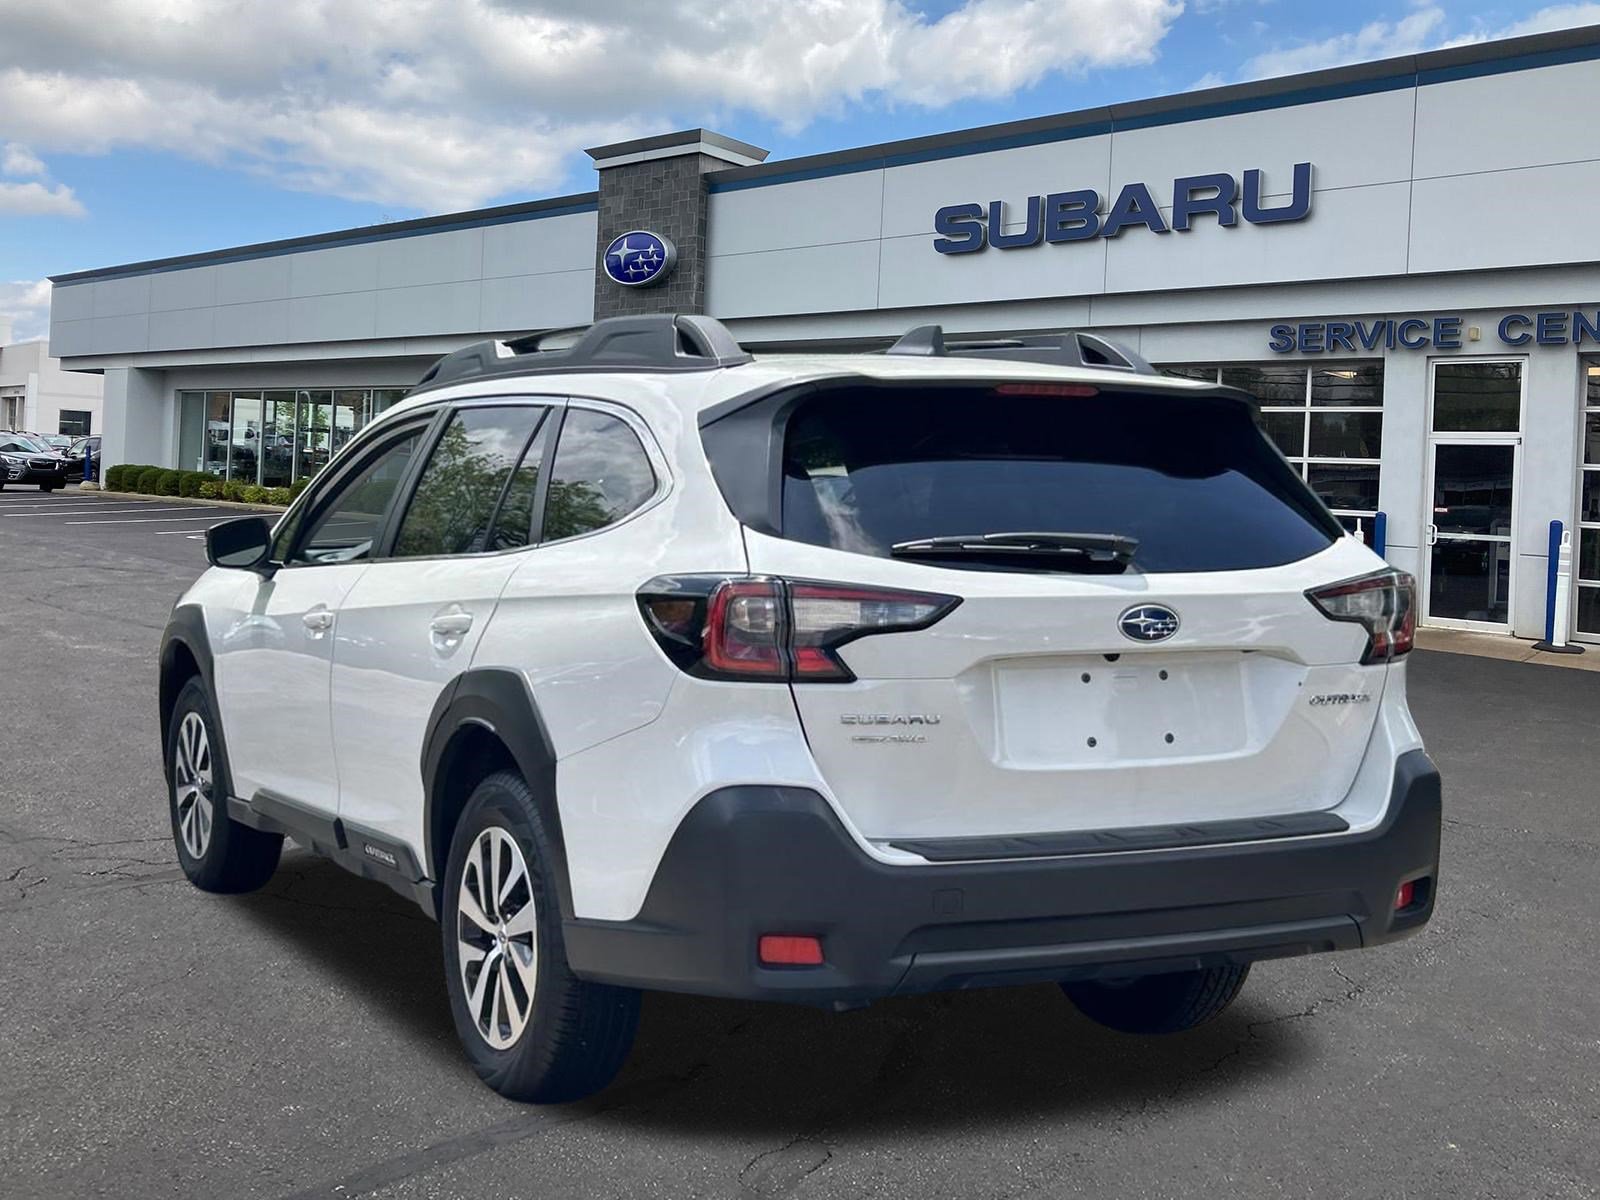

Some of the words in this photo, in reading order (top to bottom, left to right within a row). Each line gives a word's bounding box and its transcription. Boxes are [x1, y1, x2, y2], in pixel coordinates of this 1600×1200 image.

[934, 162, 1313, 255] SUBARU
[1269, 317, 1463, 353] SERVICE
[1498, 311, 1600, 346] CEN
[840, 713, 941, 725] SUBARU
